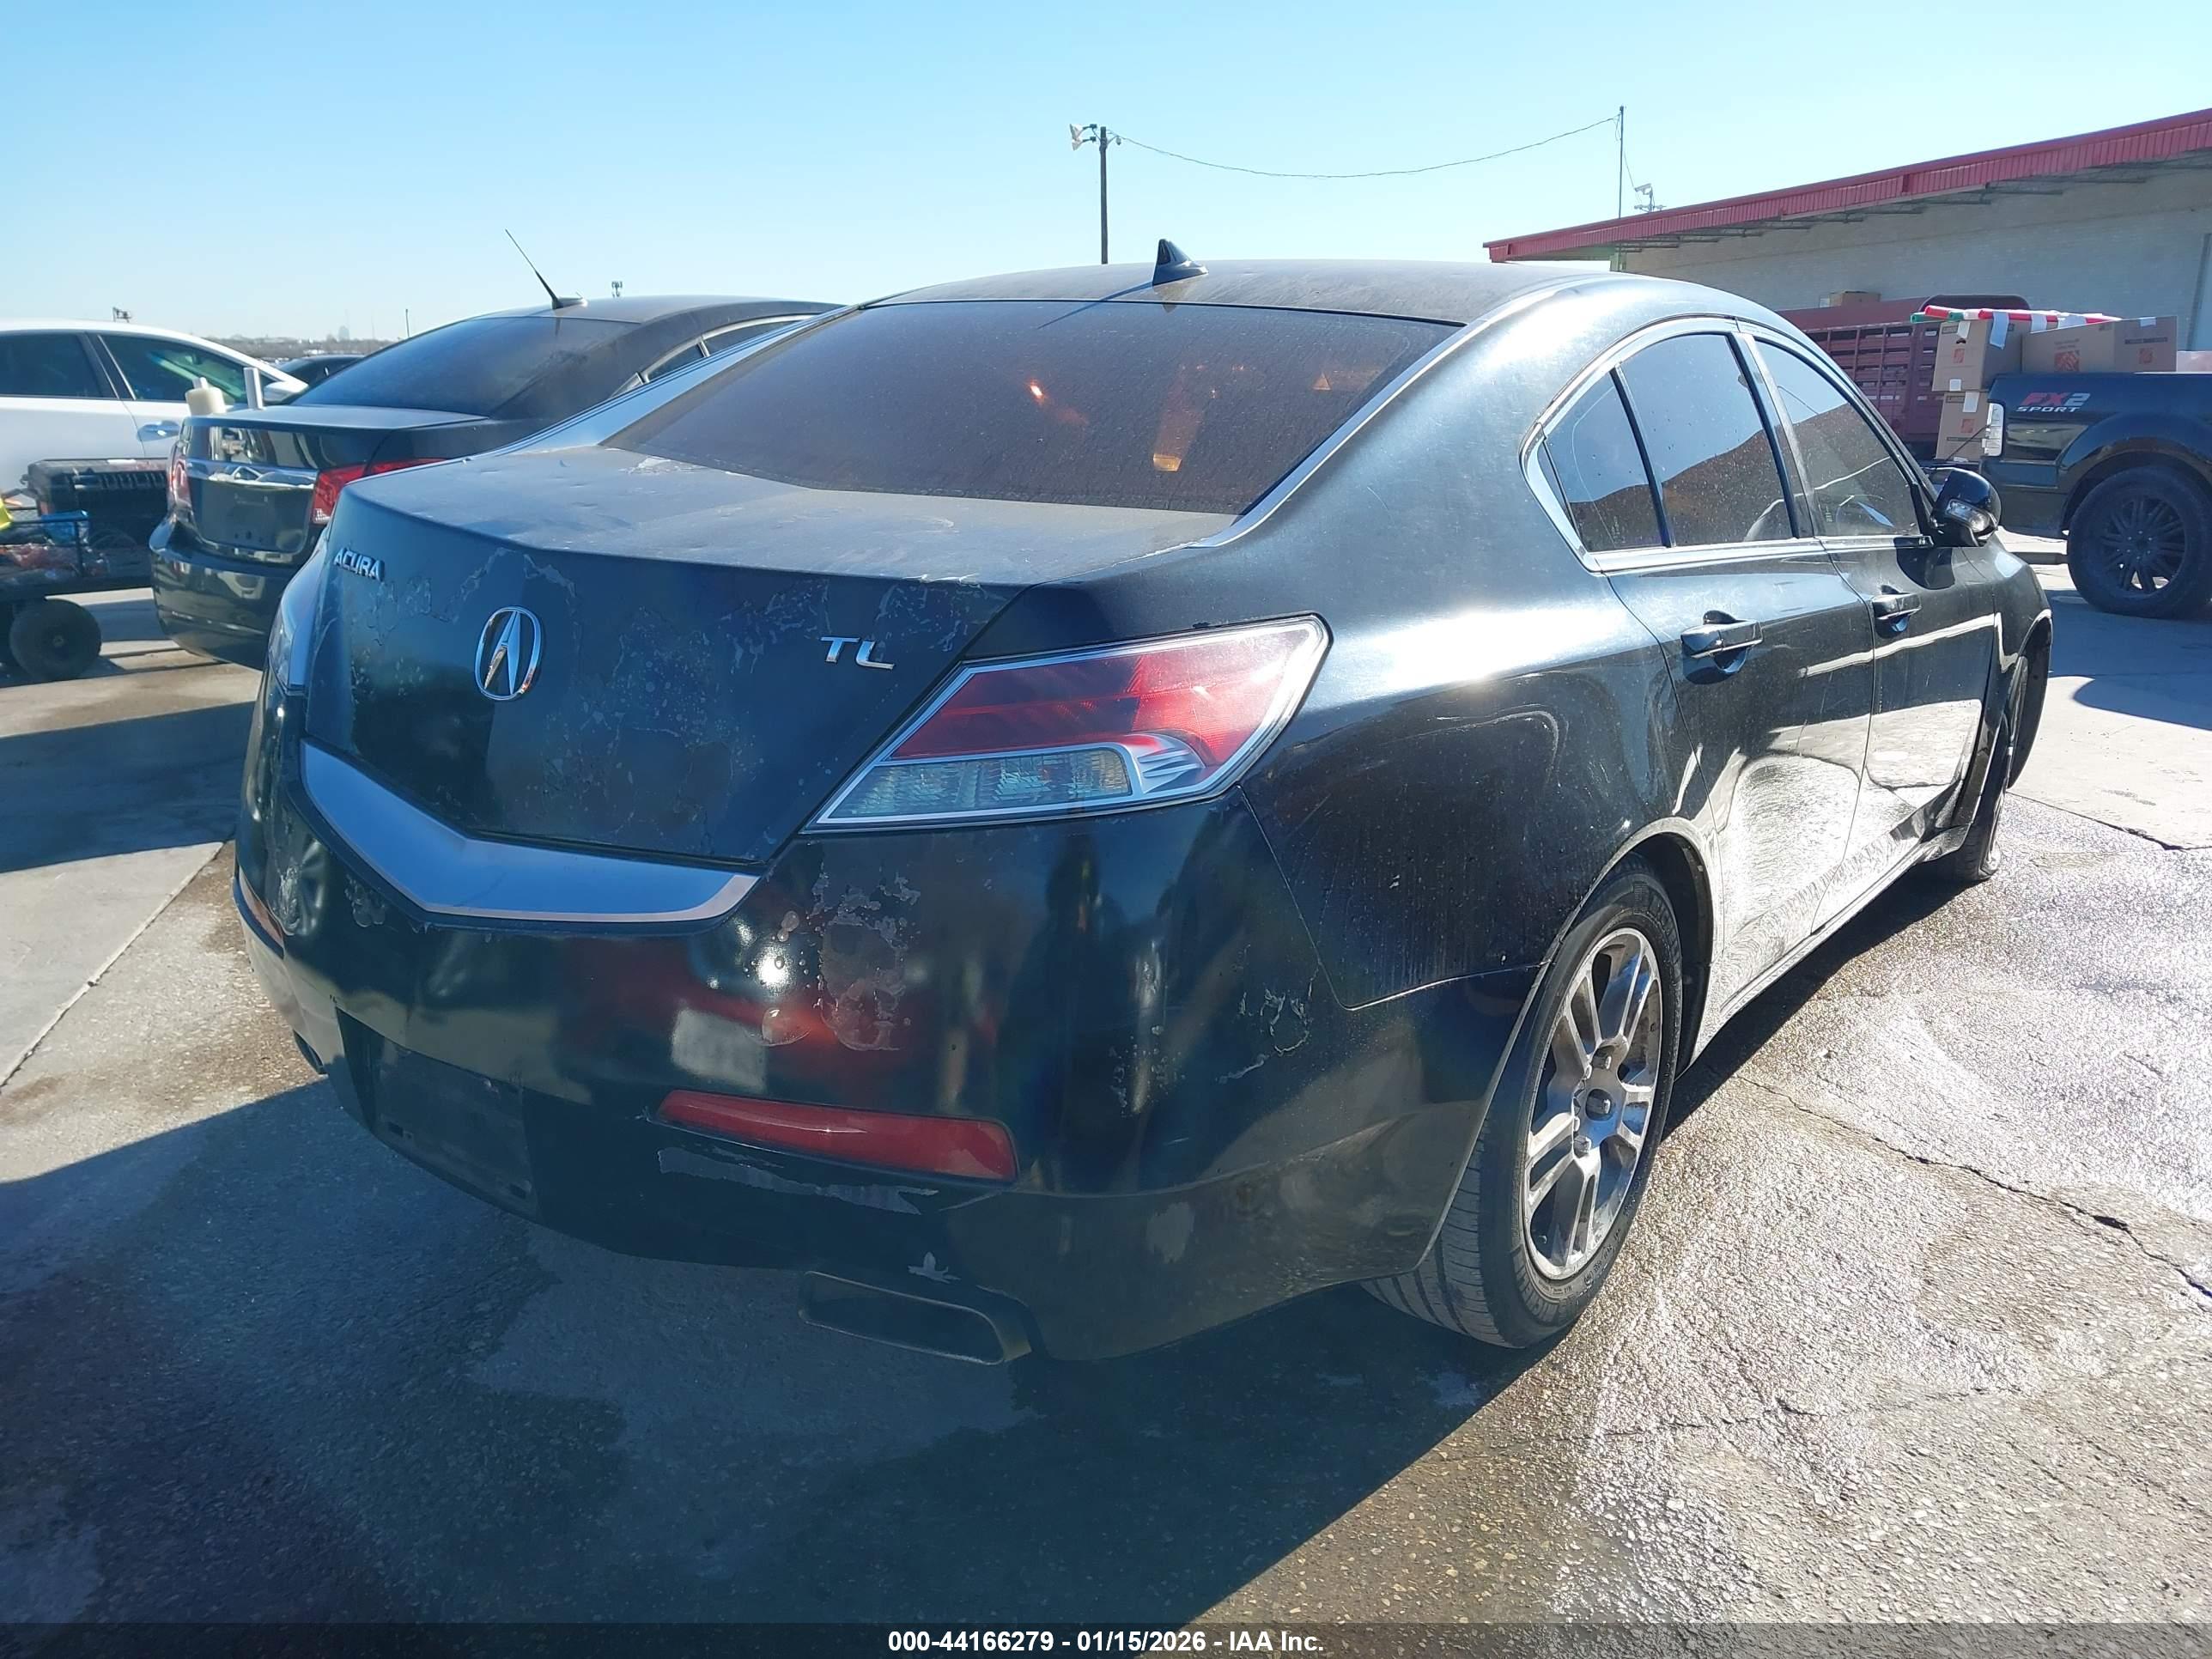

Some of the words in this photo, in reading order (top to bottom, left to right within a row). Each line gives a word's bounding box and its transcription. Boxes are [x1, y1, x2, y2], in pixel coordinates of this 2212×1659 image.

[2019, 392, 2091, 407] FX2
[333, 547, 382, 581] ACURA
[820, 635, 896, 671] TL
